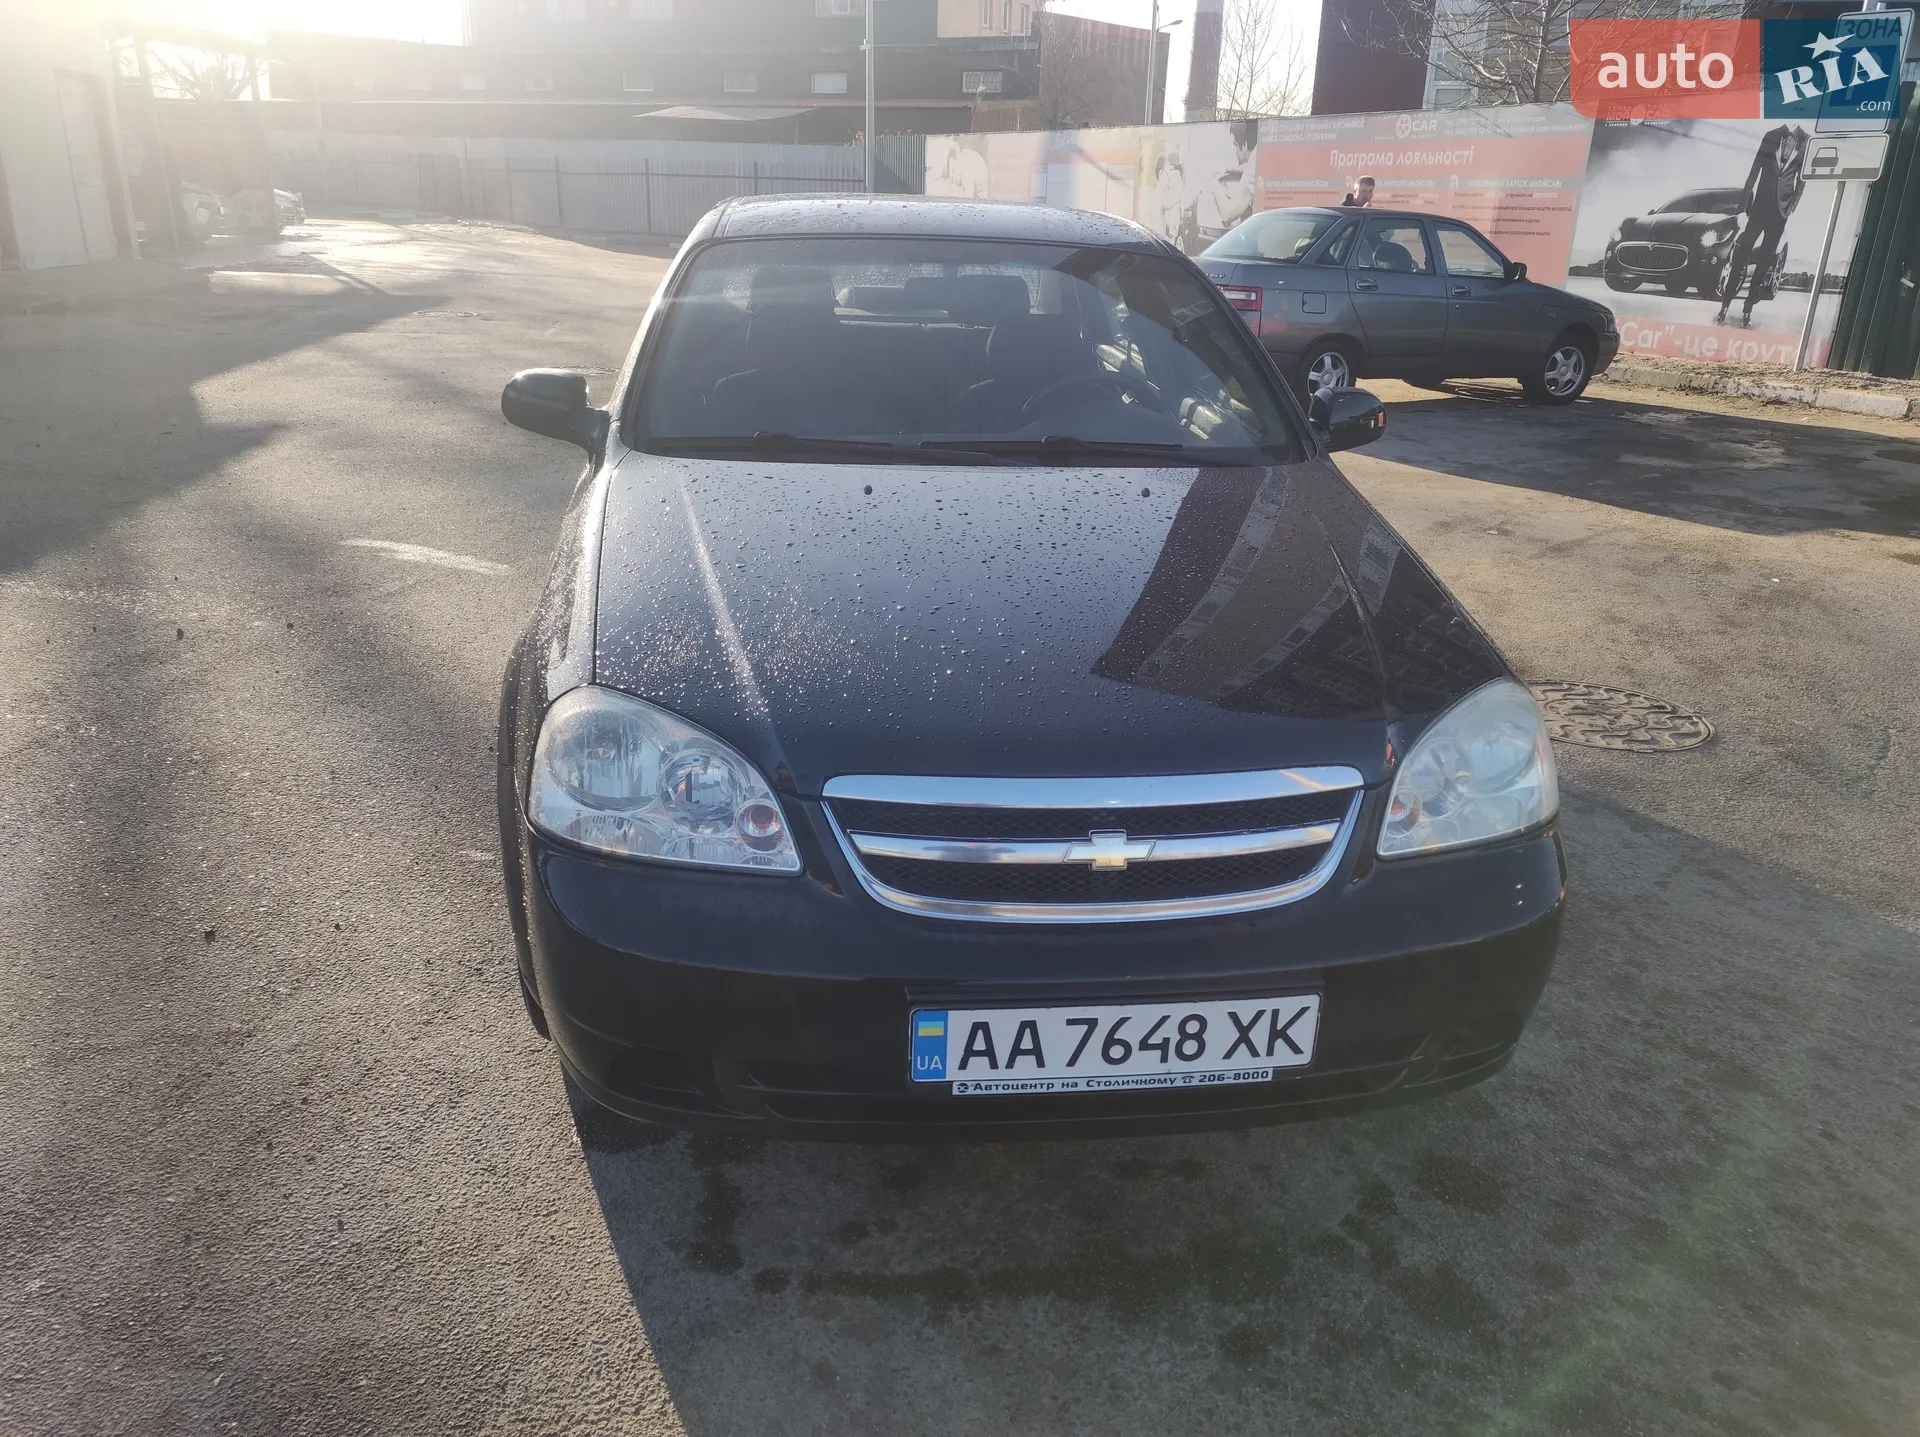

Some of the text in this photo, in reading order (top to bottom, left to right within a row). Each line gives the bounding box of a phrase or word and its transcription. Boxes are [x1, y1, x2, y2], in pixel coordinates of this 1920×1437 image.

[1330, 146, 1475, 170] Програма лояльності
[957, 1005, 1311, 1071] AA 7648 XK
[917, 1055, 943, 1071] UA
[972, 1070, 1270, 1092] Автоцентр на Столичному 206-8000
